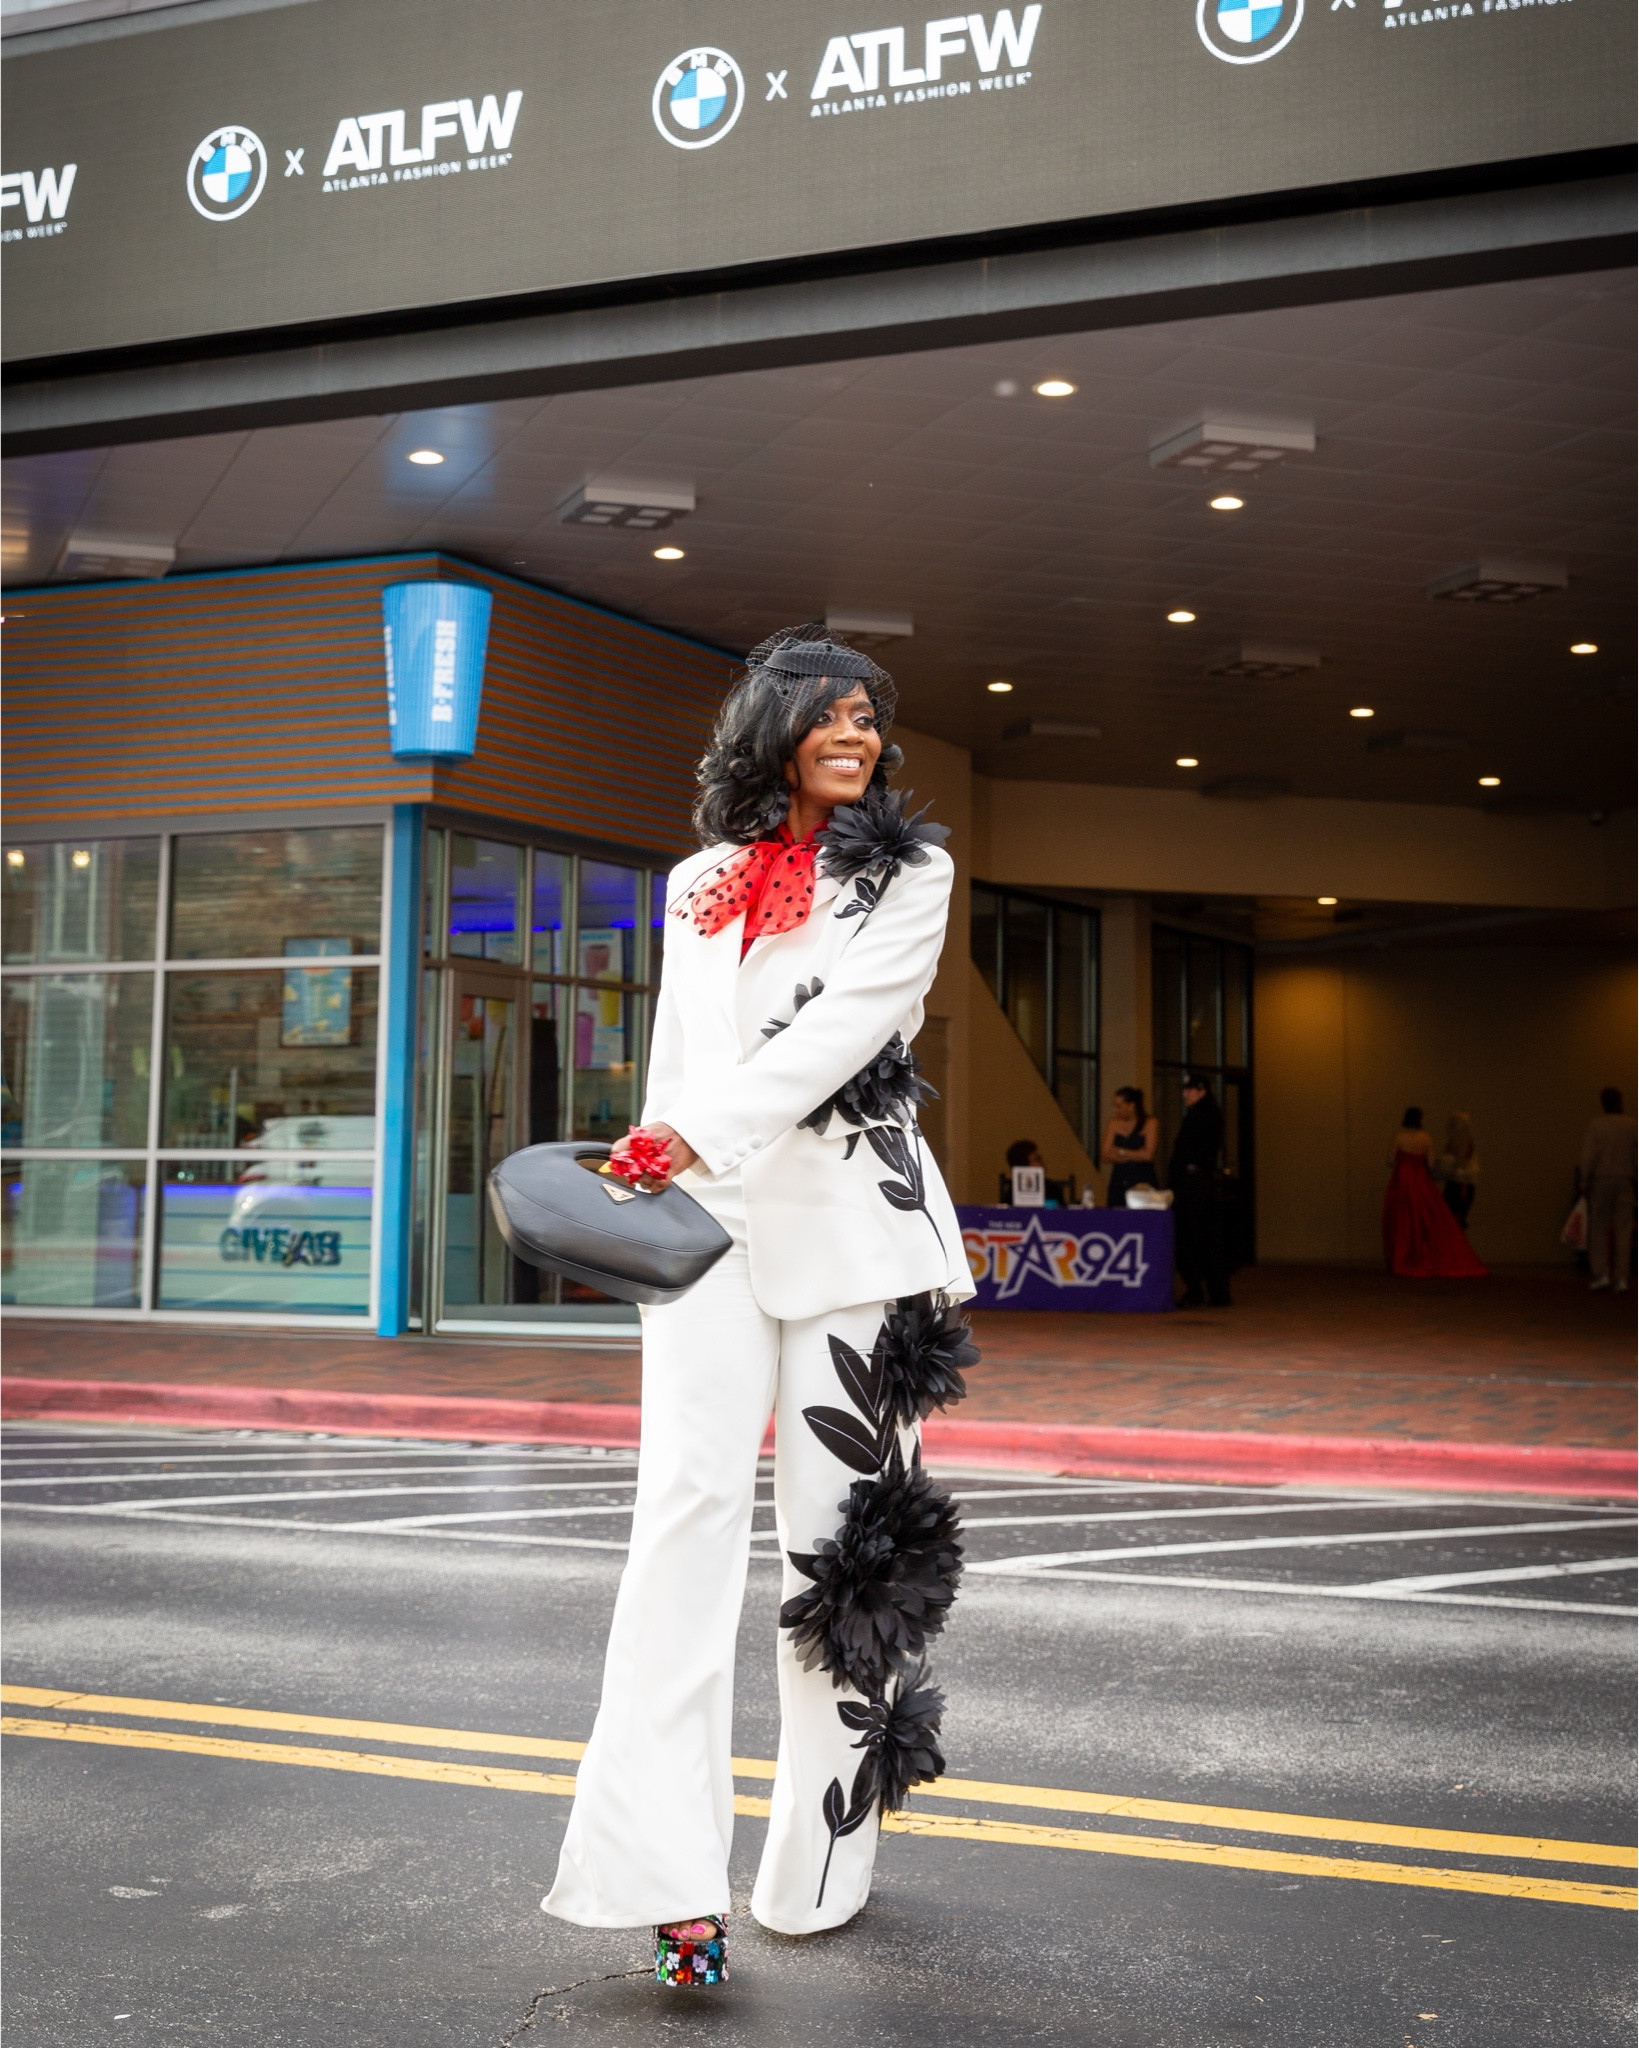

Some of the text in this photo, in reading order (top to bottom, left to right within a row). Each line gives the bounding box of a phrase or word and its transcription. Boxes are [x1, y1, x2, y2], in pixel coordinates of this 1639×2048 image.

[665, 53, 733, 86] BMW
[810, 3, 1043, 100] ATLFW
[810, 94, 887, 118] ATLANTA
[893, 81, 971, 104] FASHION
[199, 131, 258, 162] BMW
[322, 90, 524, 177] ATLFW
[322, 172, 389, 193] ATLANTA
[393, 161, 462, 181] FASHION
